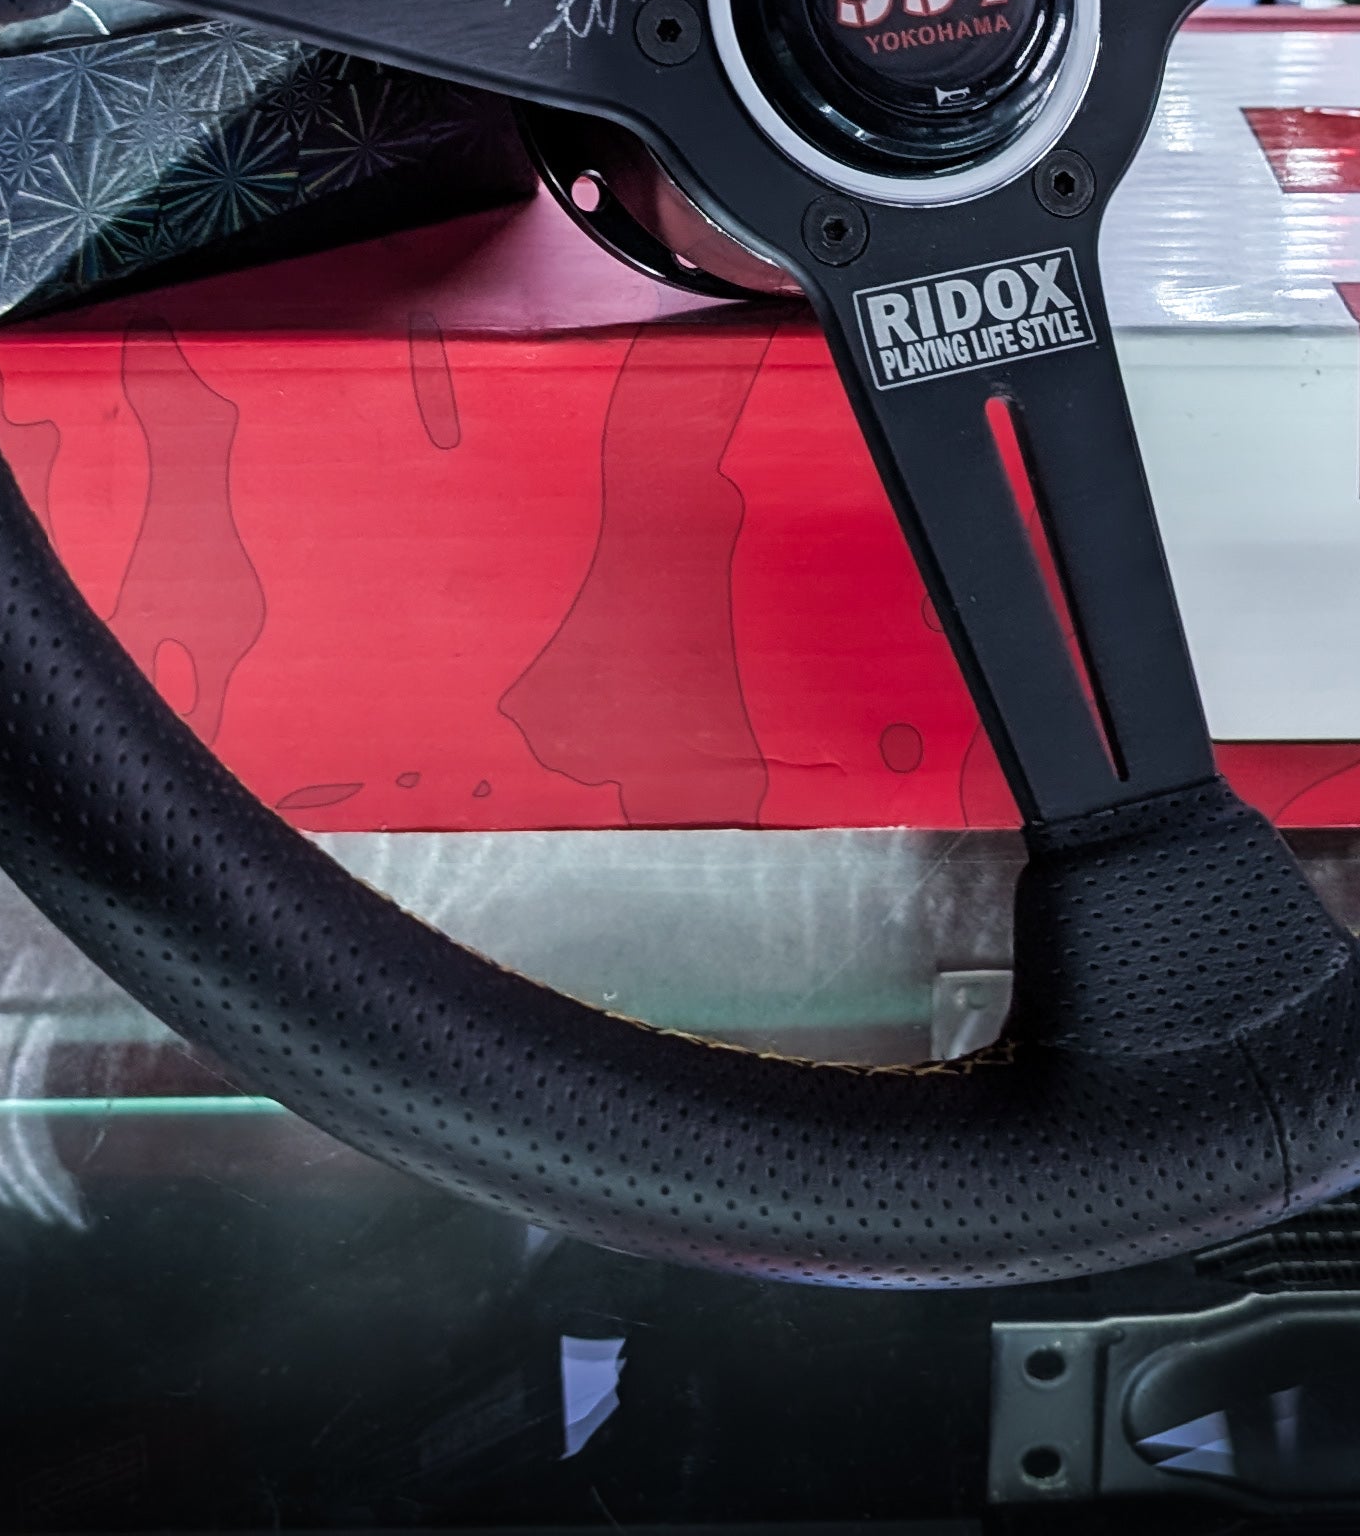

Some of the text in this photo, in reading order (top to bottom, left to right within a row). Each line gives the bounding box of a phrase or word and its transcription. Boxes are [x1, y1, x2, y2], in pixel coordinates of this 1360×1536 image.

[863, 14, 1012, 54] YOKOHAMA
[866, 257, 1075, 349] RIDOX
[879, 309, 1085, 381] PLAYING LIFE STYLE
